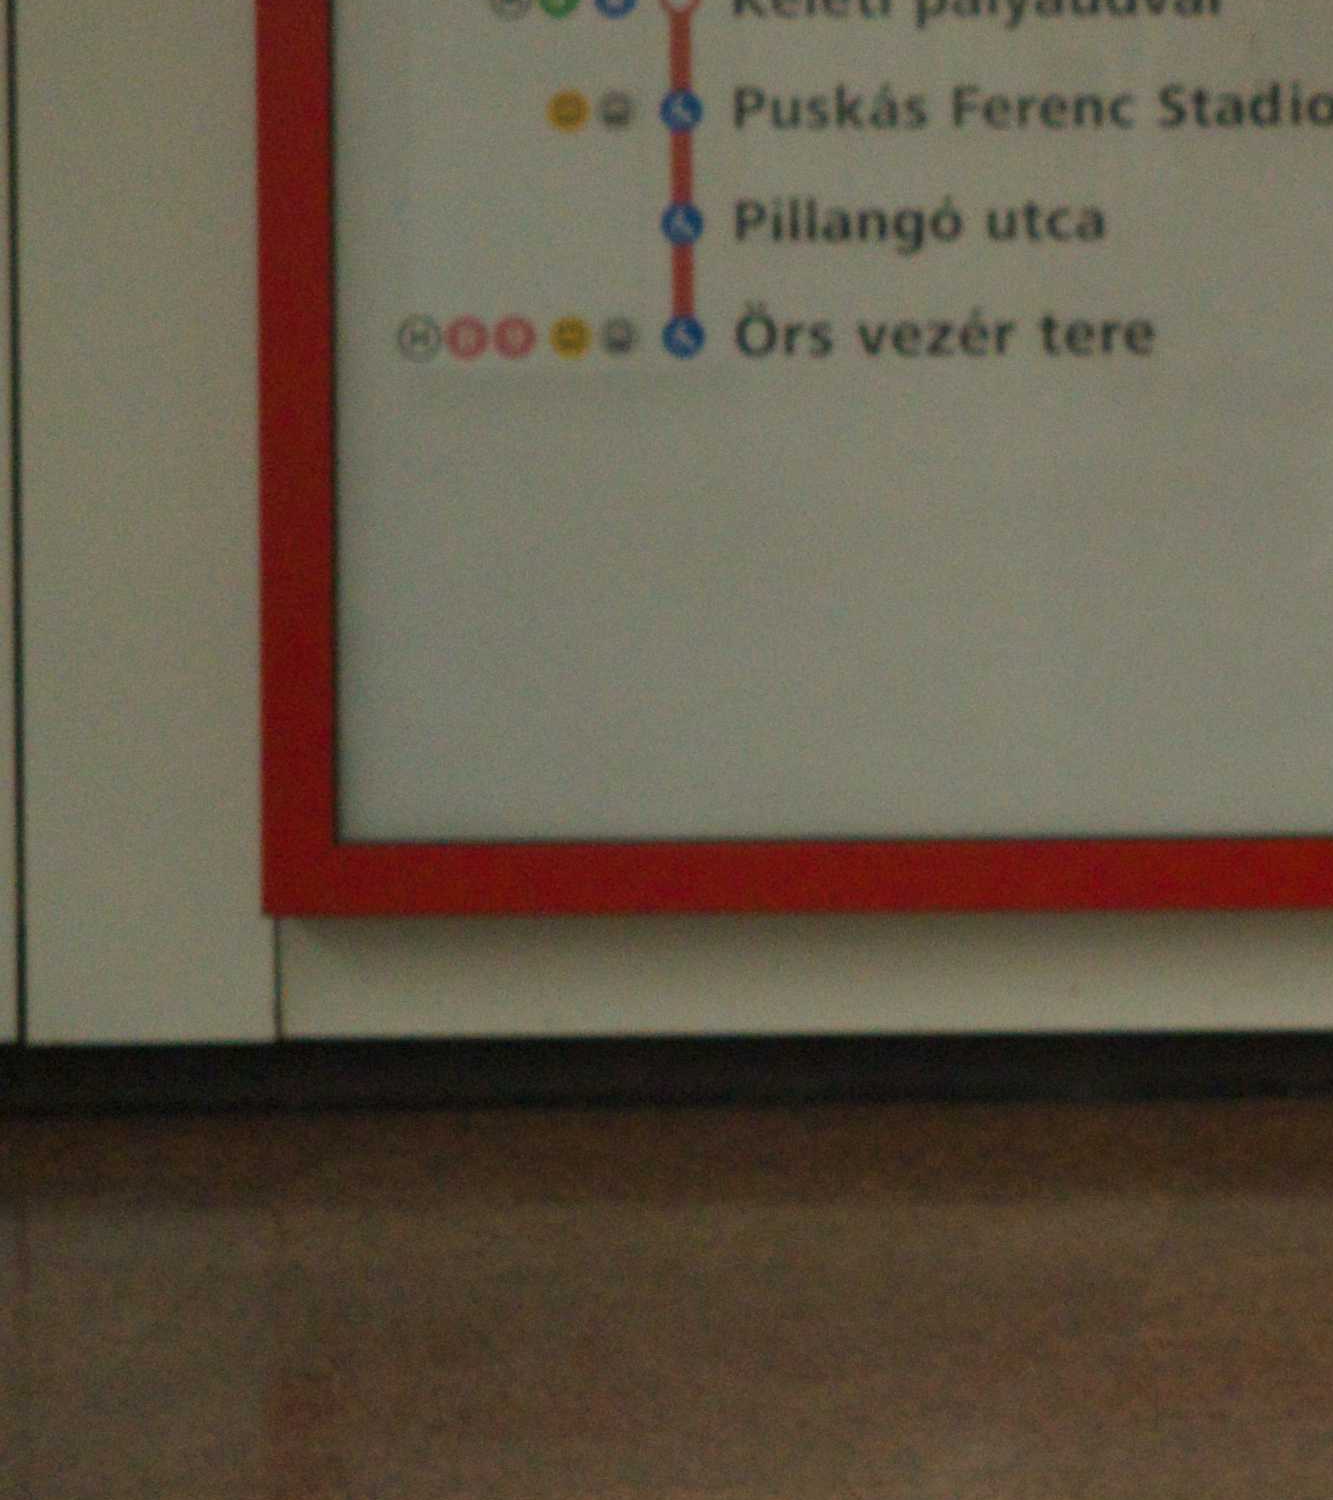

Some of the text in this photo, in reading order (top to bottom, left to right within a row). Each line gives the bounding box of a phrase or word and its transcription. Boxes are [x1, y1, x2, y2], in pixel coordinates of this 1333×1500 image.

[733, 85, 929, 130] Puskás
[951, 85, 1134, 130] Ferenc
[734, 197, 1106, 257] Pillangó utca
[856, 307, 1015, 357] vezér
[1038, 312, 1157, 356] tere
